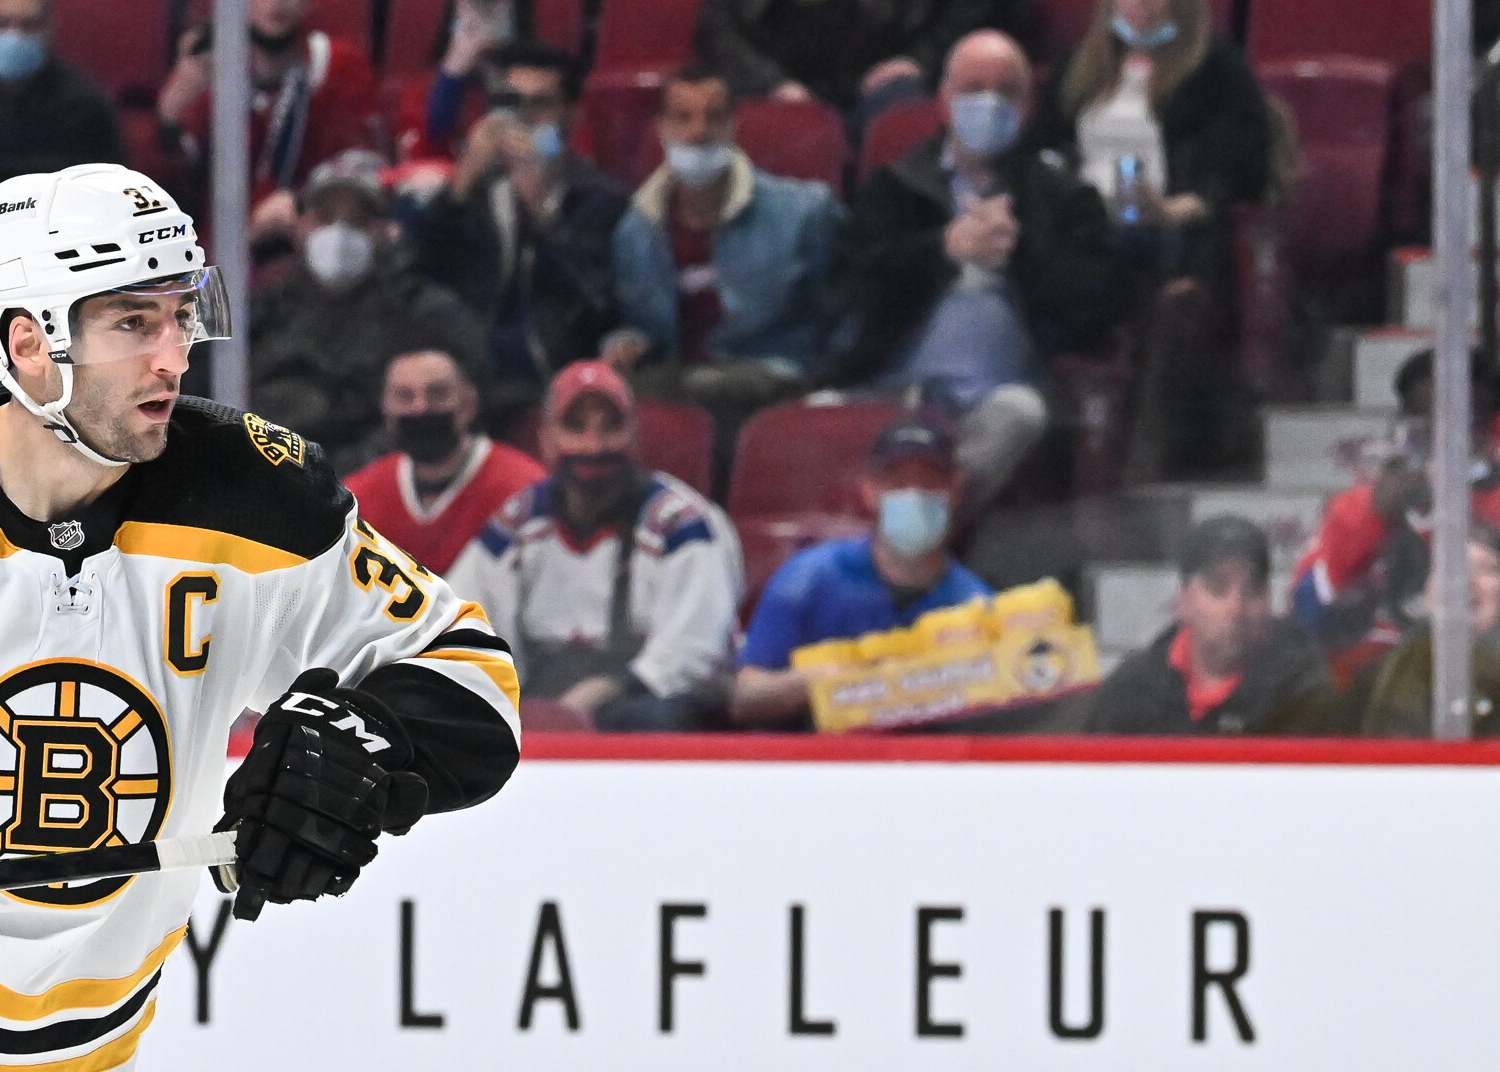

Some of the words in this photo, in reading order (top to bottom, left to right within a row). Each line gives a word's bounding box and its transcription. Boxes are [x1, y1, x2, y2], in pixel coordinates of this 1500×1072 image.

[138, 224, 186, 244] CCM
[58, 528, 76, 545] NHL
[163, 570, 221, 678] C
[5, 718, 119, 851] B
[399, 898, 1257, 1044] LAFLEUR
